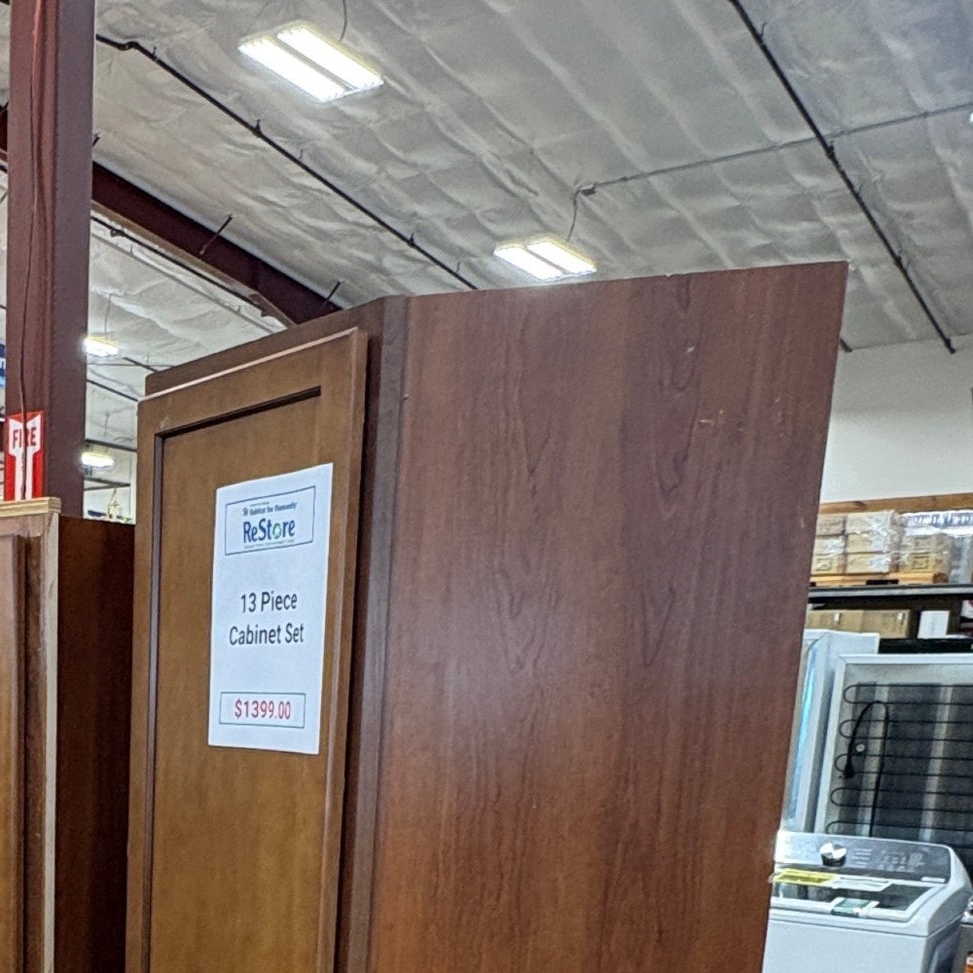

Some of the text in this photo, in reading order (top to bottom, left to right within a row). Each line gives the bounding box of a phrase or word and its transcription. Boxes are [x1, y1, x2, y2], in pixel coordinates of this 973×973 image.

[243, 517, 296, 544] ReStore
[240, 591, 298, 613] 13 Piece
[229, 622, 304, 647] Cabinet Set
[234, 699, 291, 720] $1399.00
